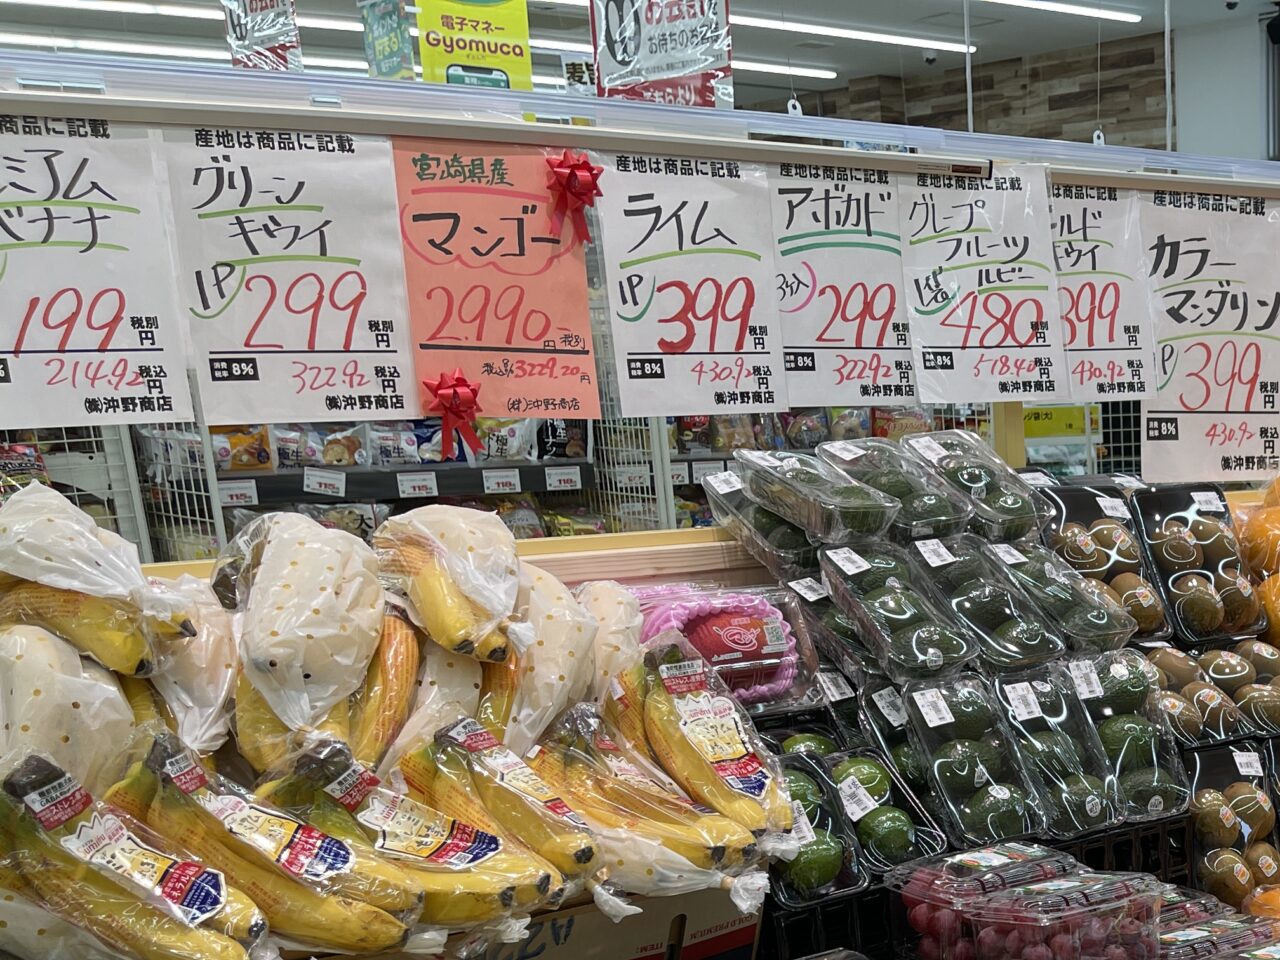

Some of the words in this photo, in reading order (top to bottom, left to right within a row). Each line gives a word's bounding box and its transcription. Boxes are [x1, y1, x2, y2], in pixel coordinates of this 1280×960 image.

[441, 16, 504, 34] 電子マネー
[425, 30, 524, 57] Gyomuca
[194, 128, 355, 154] 産地は商品に記載
[411, 153, 515, 188] 宮崎県産
[615, 155, 741, 180] 産地は商品に記載
[780, 162, 889, 185] 産地は商品に記載
[191, 155, 306, 210] グリーン
[917, 173, 1022, 191] 産地は商品に記載
[778, 185, 891, 237] アボカド
[1153, 191, 1266, 217] 産地は商品に記載
[622, 193, 738, 253] ライム
[909, 194, 985, 237] グレープ
[228, 215, 333, 258] キウイ
[412, 205, 561, 258] マンゴー
[937, 236, 1029, 263] フルーツ
[1149, 234, 1236, 280] カラー
[977, 267, 1035, 287] ルビー
[244, 271, 367, 351] 299
[1163, 280, 1280, 332] マンダリン
[656, 277, 756, 353] 399
[816, 282, 896, 348] 299
[940, 290, 1043, 350] 480
[1058, 282, 1120, 347] 399
[13, 288, 126, 358] 199
[130, 316, 158, 330] 税別
[368, 319, 394, 333] 税別
[892, 322, 910, 334] 税別
[1124, 325, 1140, 335] 税別
[139, 331, 156, 346] 円
[748, 325, 768, 337] 税別
[1036, 331, 1046, 343] 円
[375, 333, 391, 348] 円
[753, 337, 766, 350] 円
[897, 334, 908, 346] 円
[1128, 335, 1138, 346] 円
[797, 355, 813, 368] 8%
[895, 361, 912, 372] 税込
[936, 354, 951, 366] 8%
[1034, 357, 1052, 368] 税込
[1127, 360, 1143, 371] 税込
[138, 365, 167, 379] 税込
[232, 362, 255, 377] 8%
[374, 365, 400, 379] 税込
[644, 362, 662, 375] 8%
[753, 366, 772, 378] 税込
[1040, 367, 1050, 379] 円
[1131, 370, 1141, 381] 円
[758, 378, 770, 390] 円
[899, 371, 910, 384] 円
[1180, 341, 1261, 412] 399
[148, 379, 164, 395] 円
[382, 379, 398, 394] 円
[1260, 382, 1279, 394] 税別
[1264, 395, 1275, 409] 円
[1161, 423, 1176, 434] 8%
[1260, 427, 1279, 439] 税込
[1264, 440, 1275, 454] 円
[689, 920, 731, 941] PREMIUM
